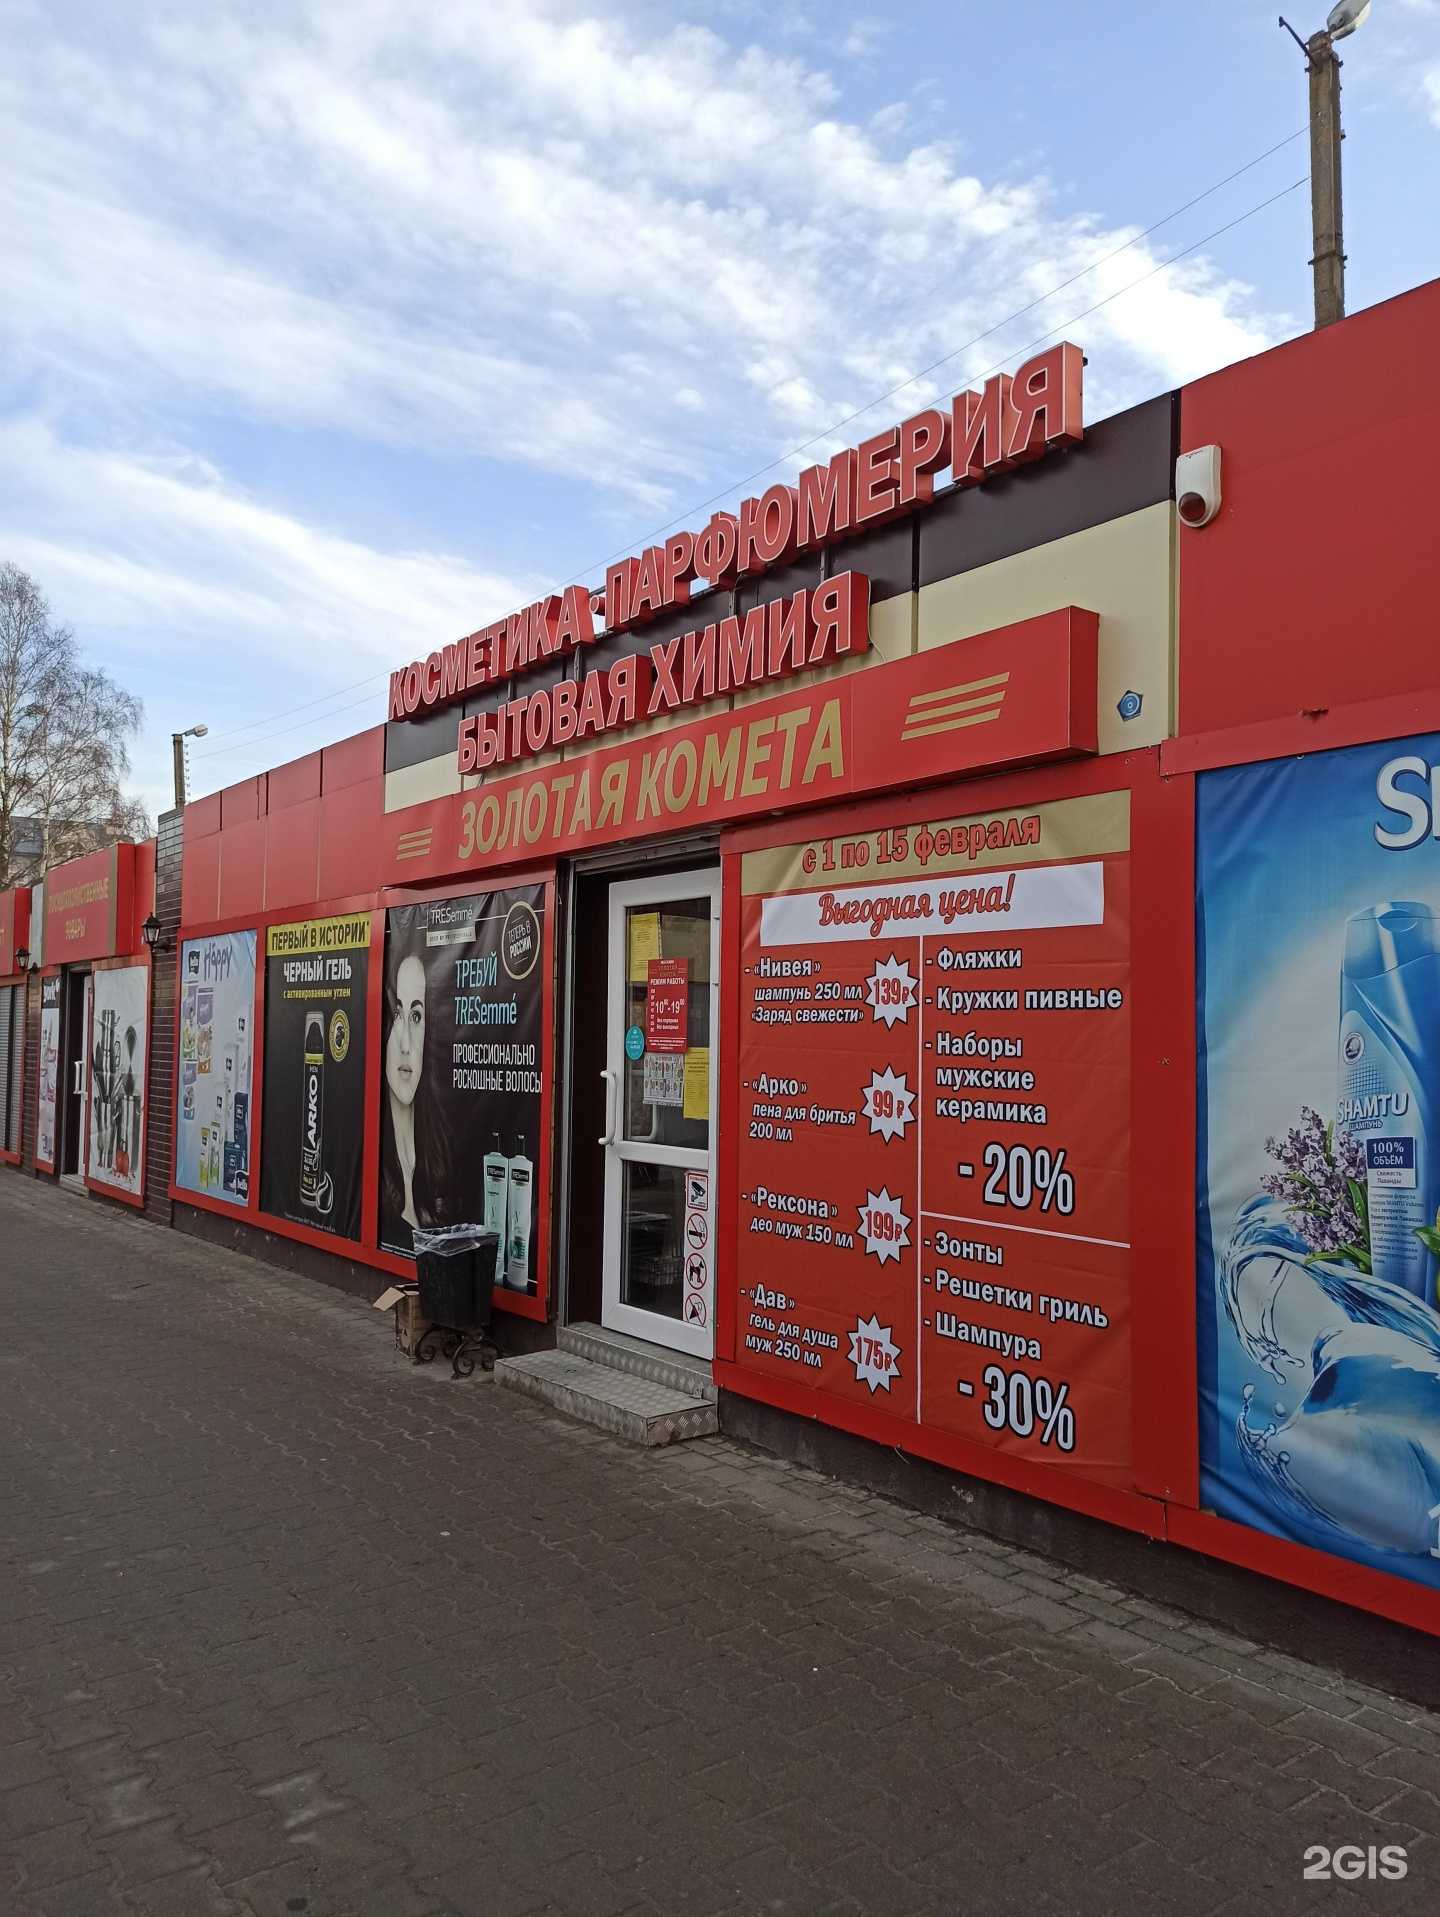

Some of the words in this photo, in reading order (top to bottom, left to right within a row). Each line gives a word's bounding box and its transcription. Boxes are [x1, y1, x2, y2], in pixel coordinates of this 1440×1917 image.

[388, 585, 594, 721] КОСМЕТИКА
[606, 341, 1084, 632] ПАРФЮМЕРИЯ
[457, 654, 650, 776] БЫТОВАЯ
[648, 570, 870, 715] ХИМИЯ
[458, 766, 627, 860] ЗОЛОТАЯ
[637, 699, 845, 821] КОМЕТА
[802, 848, 817, 873] с
[822, 839, 836, 871] 1
[841, 840, 869, 867] по
[876, 829, 908, 864] 15
[914, 815, 1041, 864] февраля
[431, 904, 473, 924] TRESemmé
[818, 892, 934, 937] Выгодная
[938, 873, 1016, 924] цена!
[272, 925, 308, 951] ПЕРВЫЙ
[311, 928, 317, 948] В
[283, 955, 323, 983] ЧЕРНЫЙ
[326, 958, 352, 981] ГЕЛЬ
[455, 951, 497, 989] ТРЕБУЙ
[937, 946, 1022, 971] Фляжки
[754, 984, 811, 1003] шампунь
[814, 982, 841, 1001] 250
[844, 986, 864, 1000] мл
[937, 987, 1018, 1014] Кружки
[1025, 985, 1122, 1010] пивные
[454, 993, 517, 1025] TRESemmé
[453, 1043, 535, 1066] ПРОФЕССИОНАЛЬНО
[936, 1031, 1022, 1060] Наборы
[453, 1069, 503, 1091] РОСКОШНЫЕ
[505, 1071, 543, 1093] ВОЛОСЫ
[936, 1065, 1035, 1090] мужские
[307, 1074, 319, 1148] ARKO
[753, 1103, 782, 1119] пена
[784, 1106, 806, 1121] для
[809, 1104, 856, 1125] бритья
[936, 1097, 1048, 1125] керамика
[1337, 1093, 1408, 1125] SHAMTU
[749, 1122, 773, 1139] 200
[776, 1126, 793, 1142] мл
[1372, 1142, 1404, 1153] 100%
[1373, 1154, 1403, 1165] ОБЪЁМ
[750, 1217, 773, 1233] део
[775, 1221, 802, 1239] муж
[805, 1224, 832, 1244] 150
[835, 1232, 854, 1249] мл
[935, 1232, 1003, 1265] Зонты
[935, 1269, 1033, 1311] Решетки
[1038, 1294, 1110, 1328] гриль
[749, 1312, 776, 1332] гель
[777, 1321, 800, 1337] для
[802, 1328, 839, 1349] душа
[935, 1312, 1042, 1361] Шампура
[745, 1335, 773, 1353] муж
[774, 1340, 801, 1360] 250
[803, 1350, 822, 1368] мл
